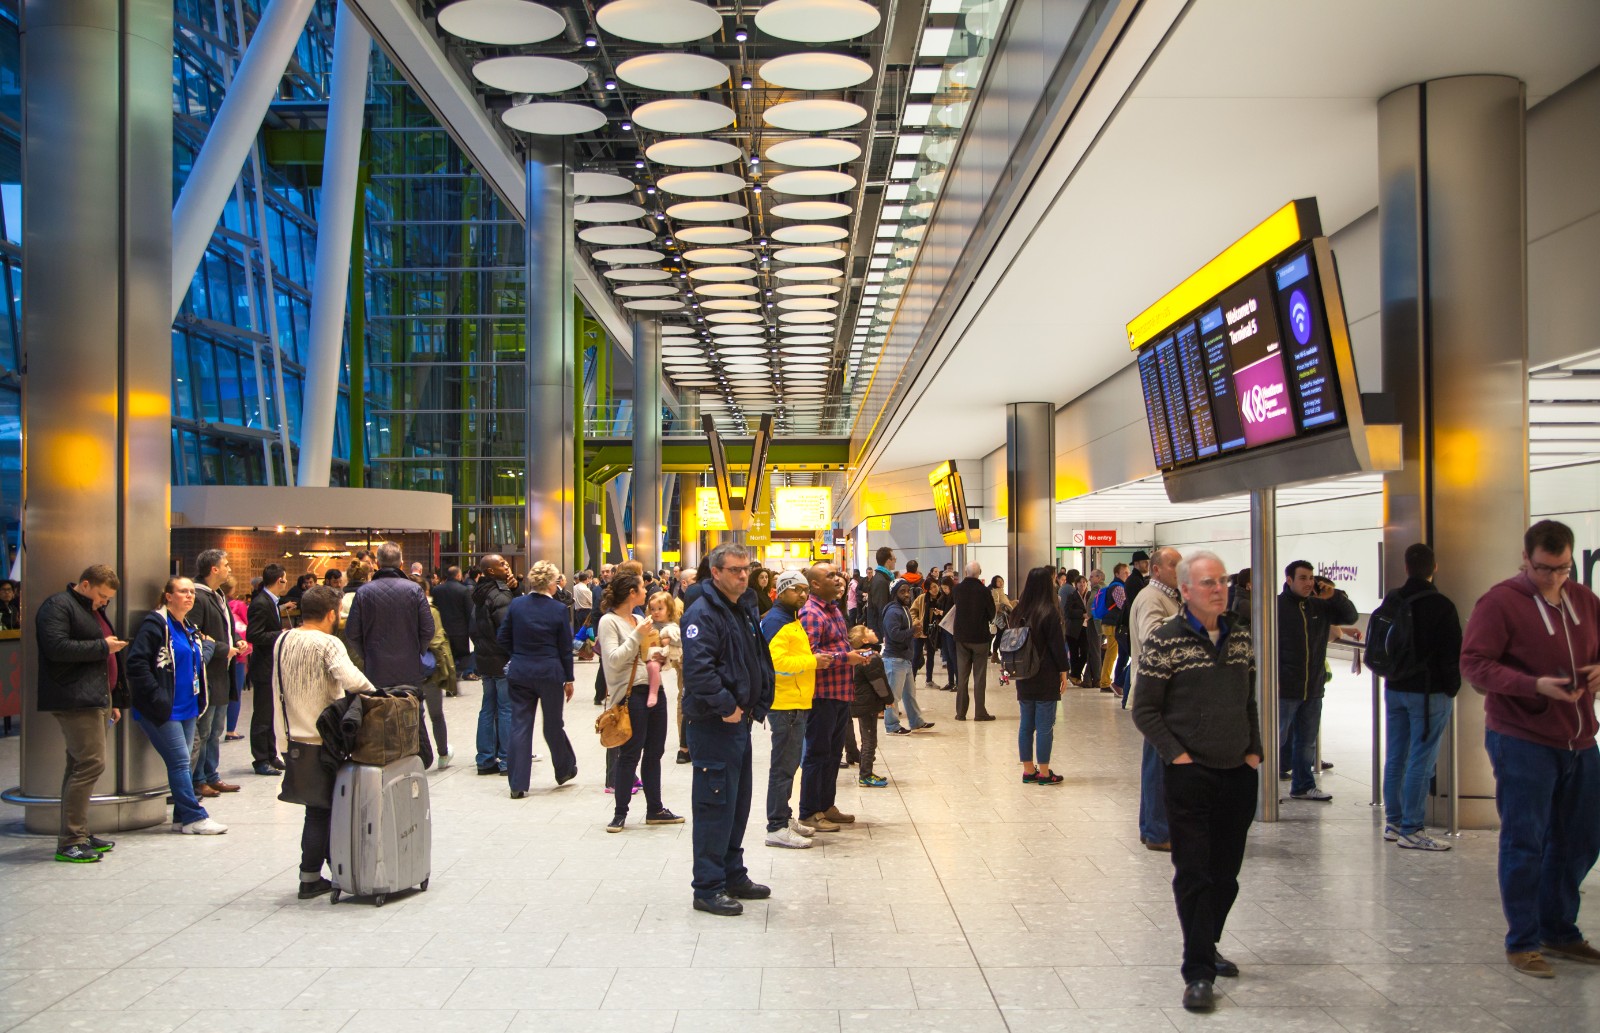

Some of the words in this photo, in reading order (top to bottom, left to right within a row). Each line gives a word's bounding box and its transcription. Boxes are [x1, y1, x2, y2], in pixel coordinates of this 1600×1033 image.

[1226, 302, 1250, 326] Welcome
[1249, 298, 1257, 313] to
[1229, 320, 1252, 346] Terminal
[1251, 318, 1258, 335] 5
[1317, 560, 1358, 581] Heathrow
